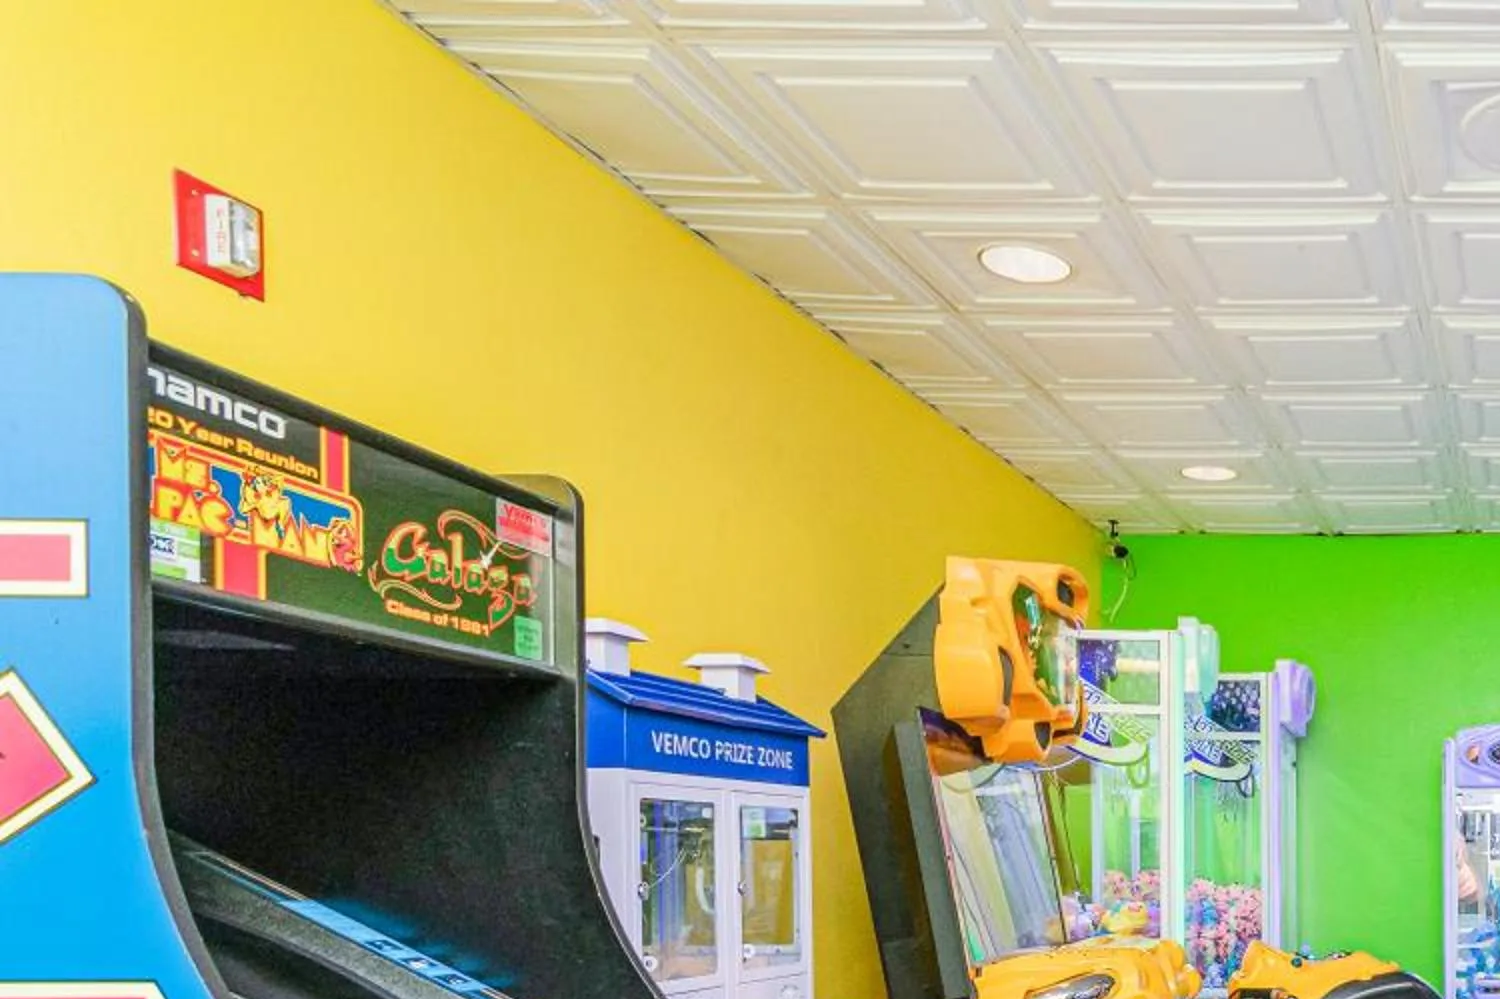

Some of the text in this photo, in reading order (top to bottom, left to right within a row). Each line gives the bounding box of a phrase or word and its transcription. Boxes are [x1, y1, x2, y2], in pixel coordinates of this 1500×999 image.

[177, 415, 235, 450] Year
[236, 437, 320, 480] Reunion
[433, 614, 449, 627] of
[651, 730, 793, 770] VEMCO PRIZE ZONE
